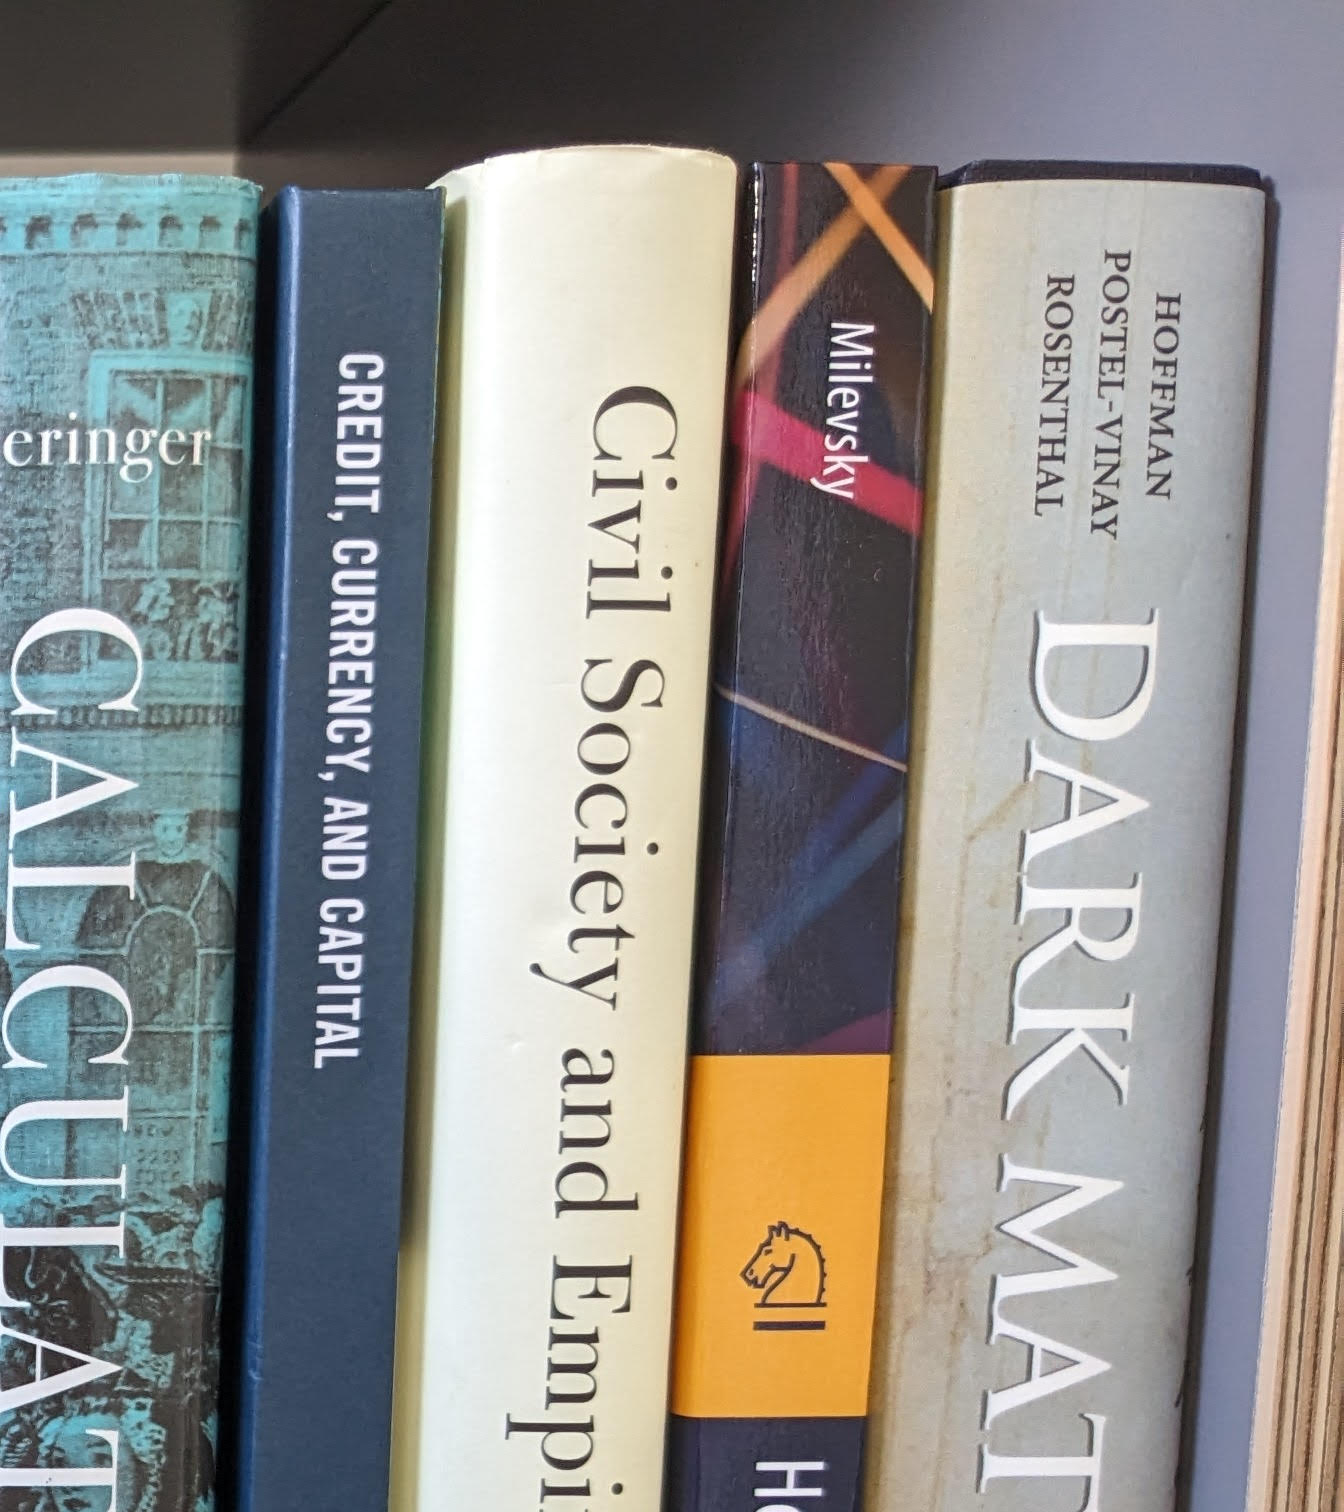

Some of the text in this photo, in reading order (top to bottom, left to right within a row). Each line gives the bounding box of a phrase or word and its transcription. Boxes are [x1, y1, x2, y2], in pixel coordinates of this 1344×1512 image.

[586, 385, 680, 621] Civil
[811, 322, 874, 499] Milevsky
[1034, 273, 1075, 517] ROSENTHAL
[1089, 249, 1132, 540] POSTEL-VINAY
[1145, 292, 1181, 500] HOFFMAN
[313, 353, 385, 1070] CREDIT, CURRENCY, AND CAPITAL
[529, 656, 667, 1012] Society
[1002, 607, 1160, 1122] DARK
[555, 1046, 639, 1220] and
